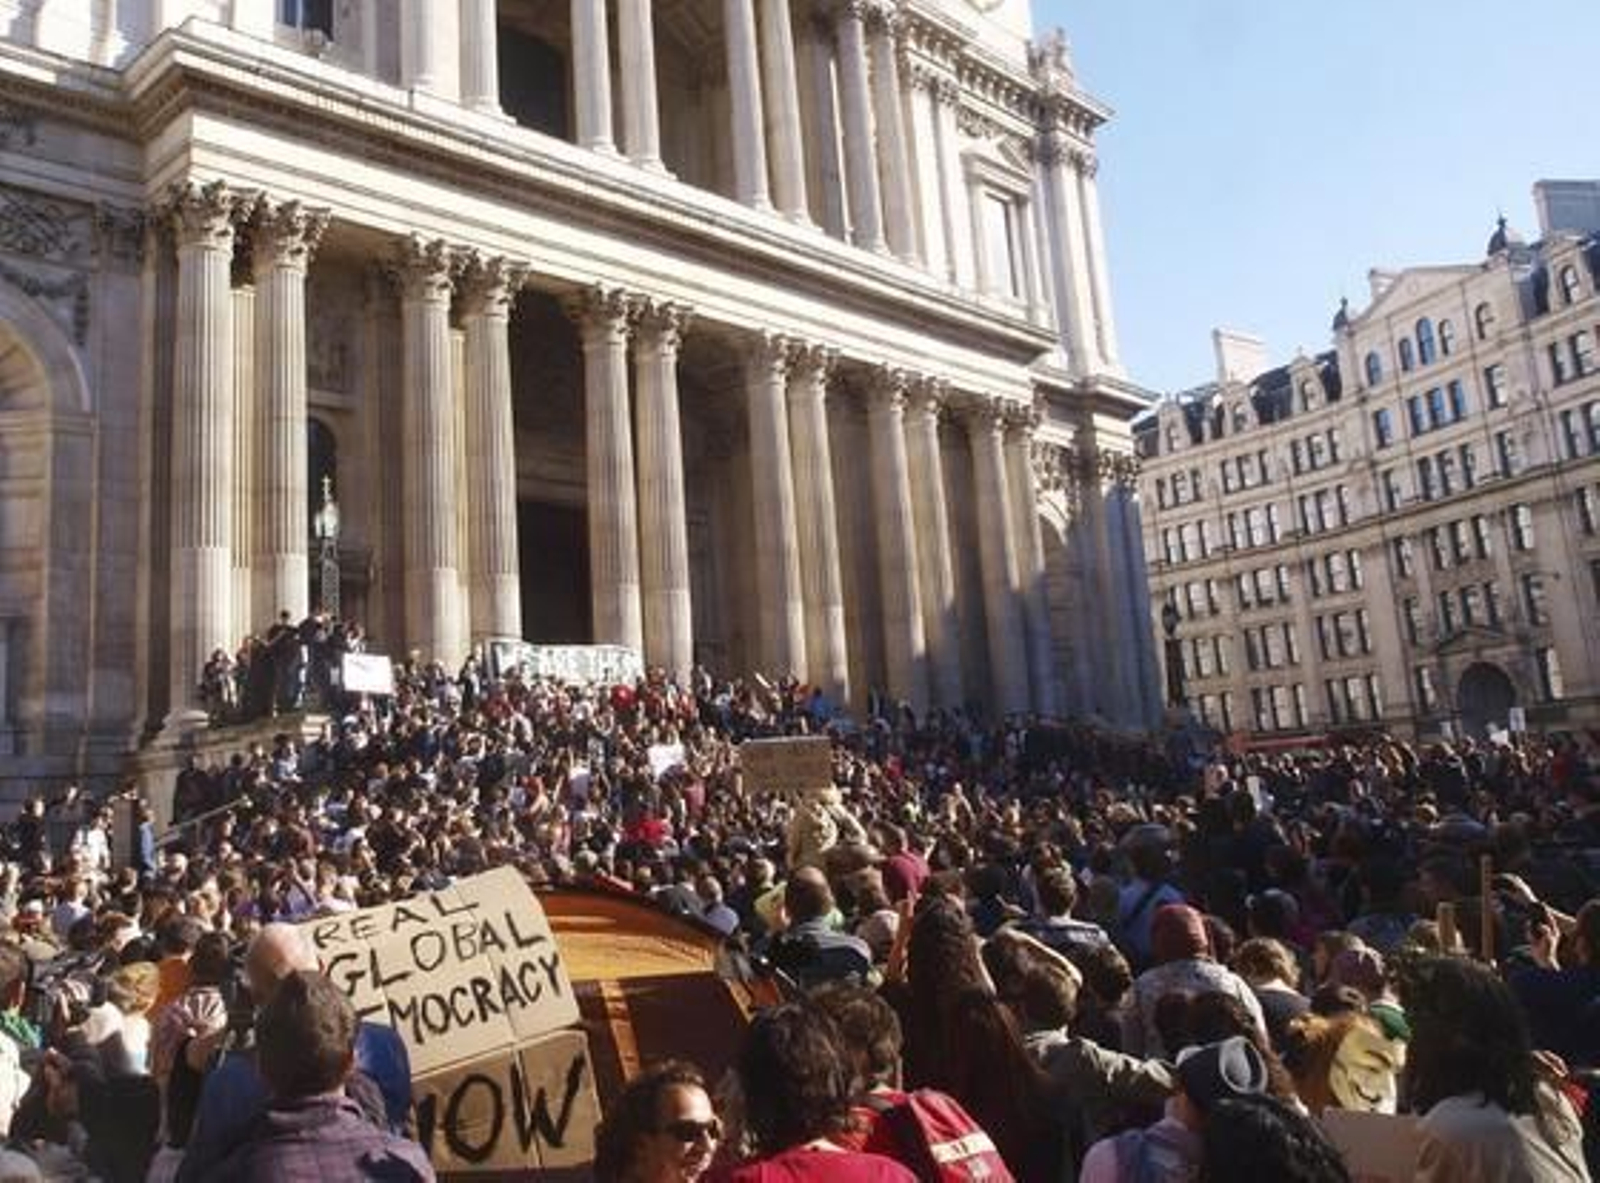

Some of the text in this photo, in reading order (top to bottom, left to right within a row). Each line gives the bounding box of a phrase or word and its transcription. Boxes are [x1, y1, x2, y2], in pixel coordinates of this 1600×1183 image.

[313, 894, 479, 948] REAL
[326, 911, 546, 996] GLOBAL
[355, 953, 561, 1045] MOCRACY
